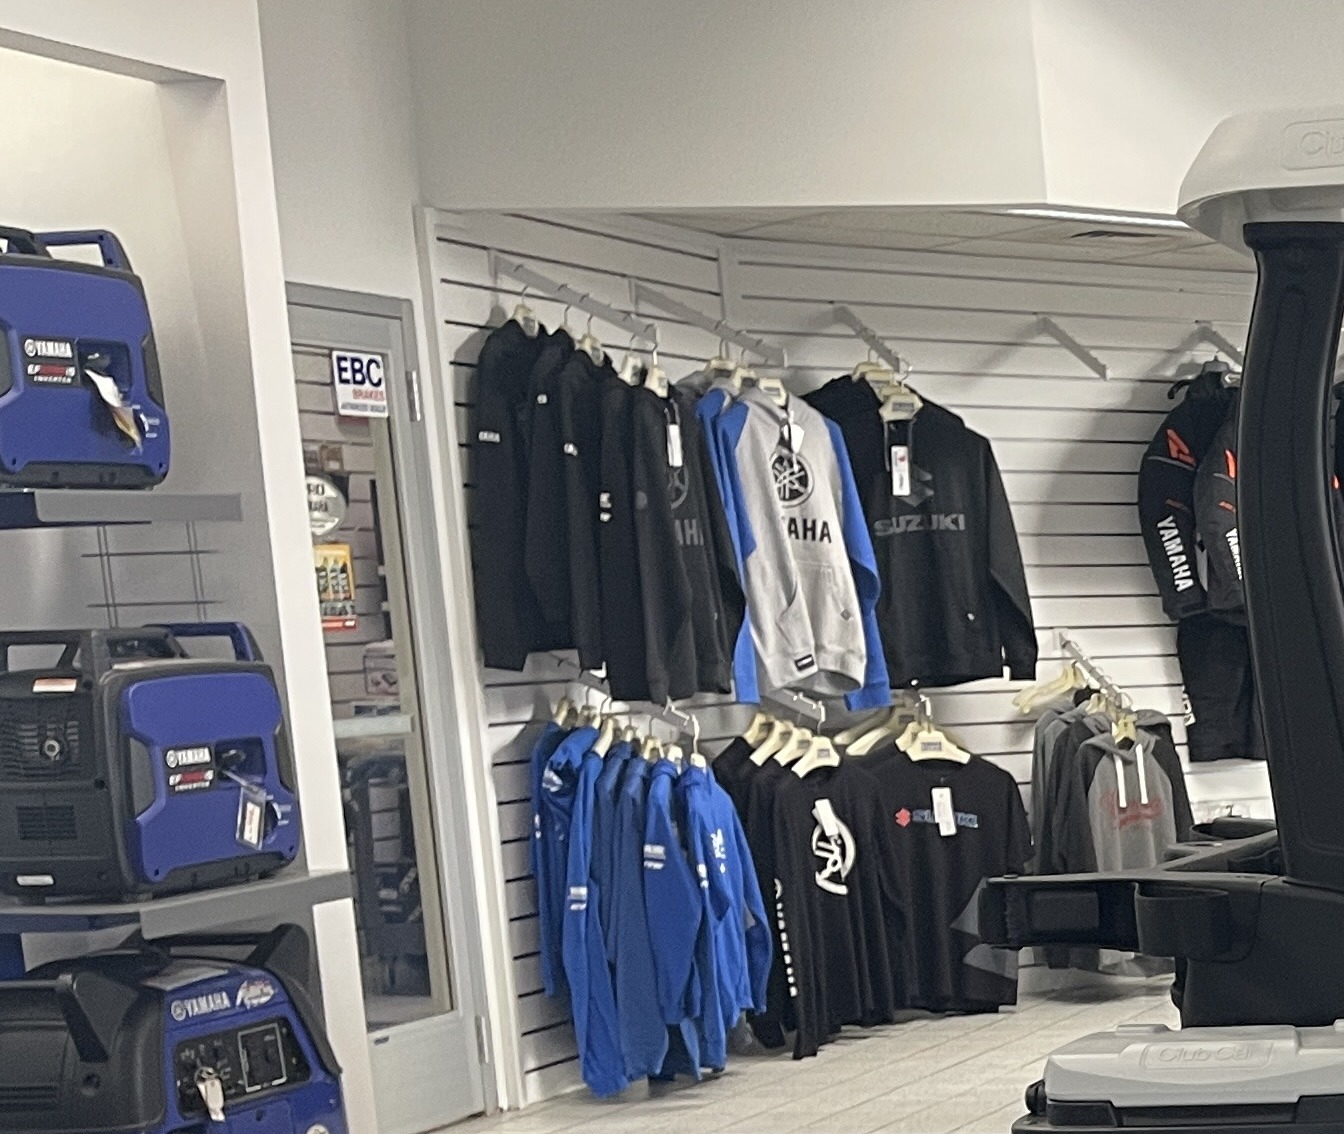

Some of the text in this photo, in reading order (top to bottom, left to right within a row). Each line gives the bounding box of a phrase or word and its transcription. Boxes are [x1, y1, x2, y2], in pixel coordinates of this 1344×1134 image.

[336, 355, 383, 388] EBC
[787, 517, 832, 543] AHA
[1157, 515, 1194, 592] YAMAHA
[183, 991, 231, 1018] YAMAHA
[1159, 1047, 1212, 1063] Club
